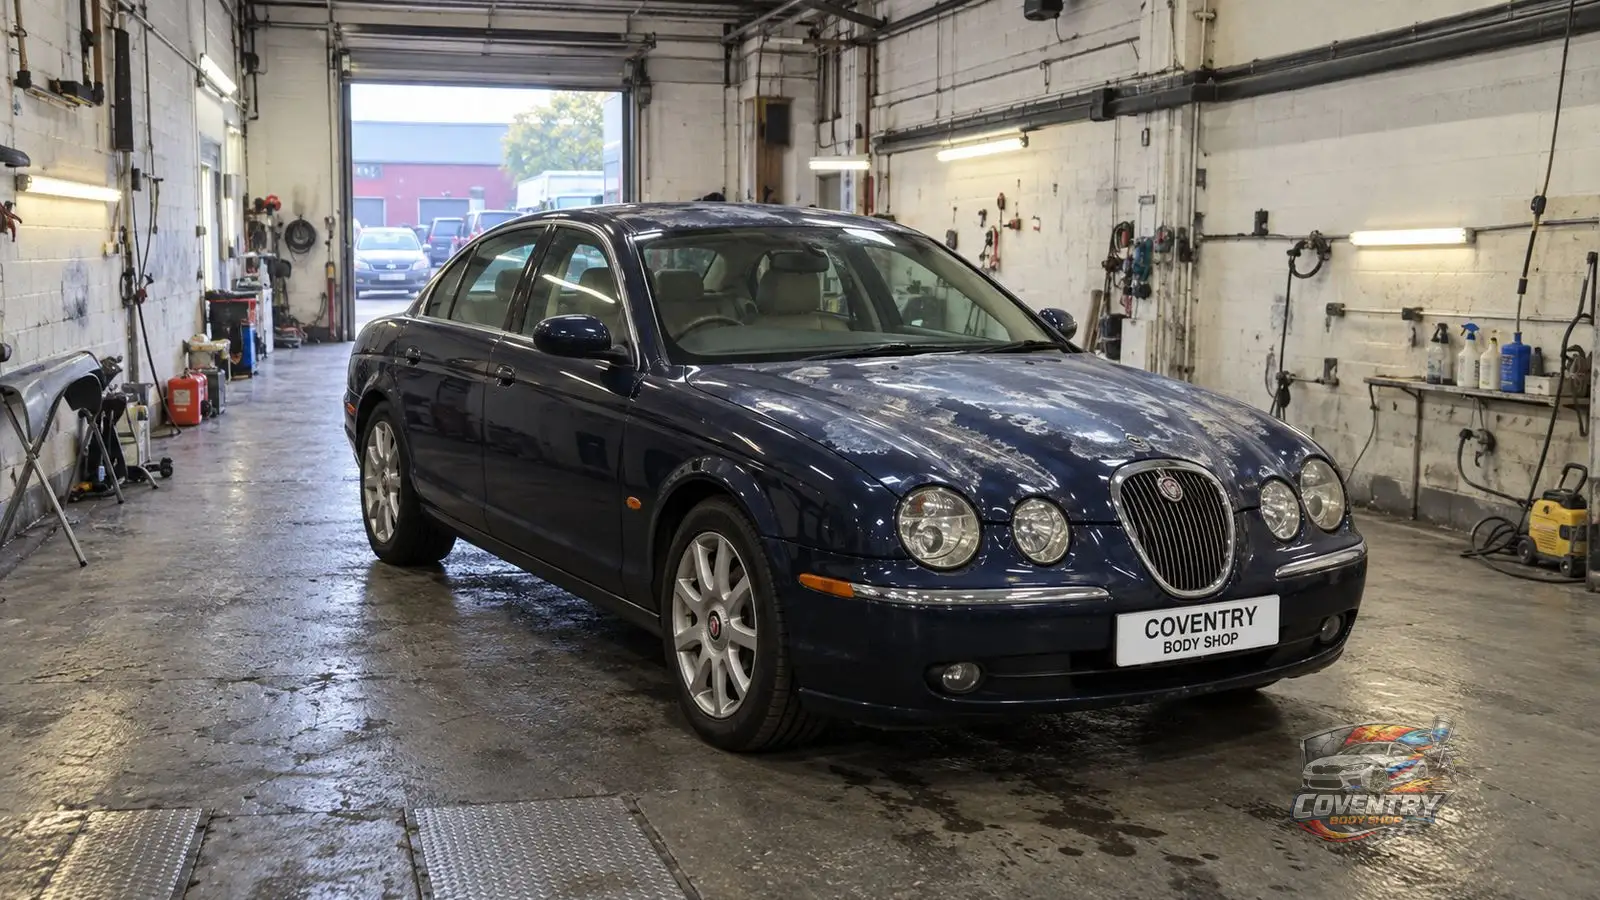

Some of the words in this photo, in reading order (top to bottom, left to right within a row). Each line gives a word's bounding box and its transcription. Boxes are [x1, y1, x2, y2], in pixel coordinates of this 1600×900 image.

[1145, 606, 1257, 639] COVENTRY
[1164, 638, 1200, 654] BODY
[1204, 632, 1239, 648] SHOP
